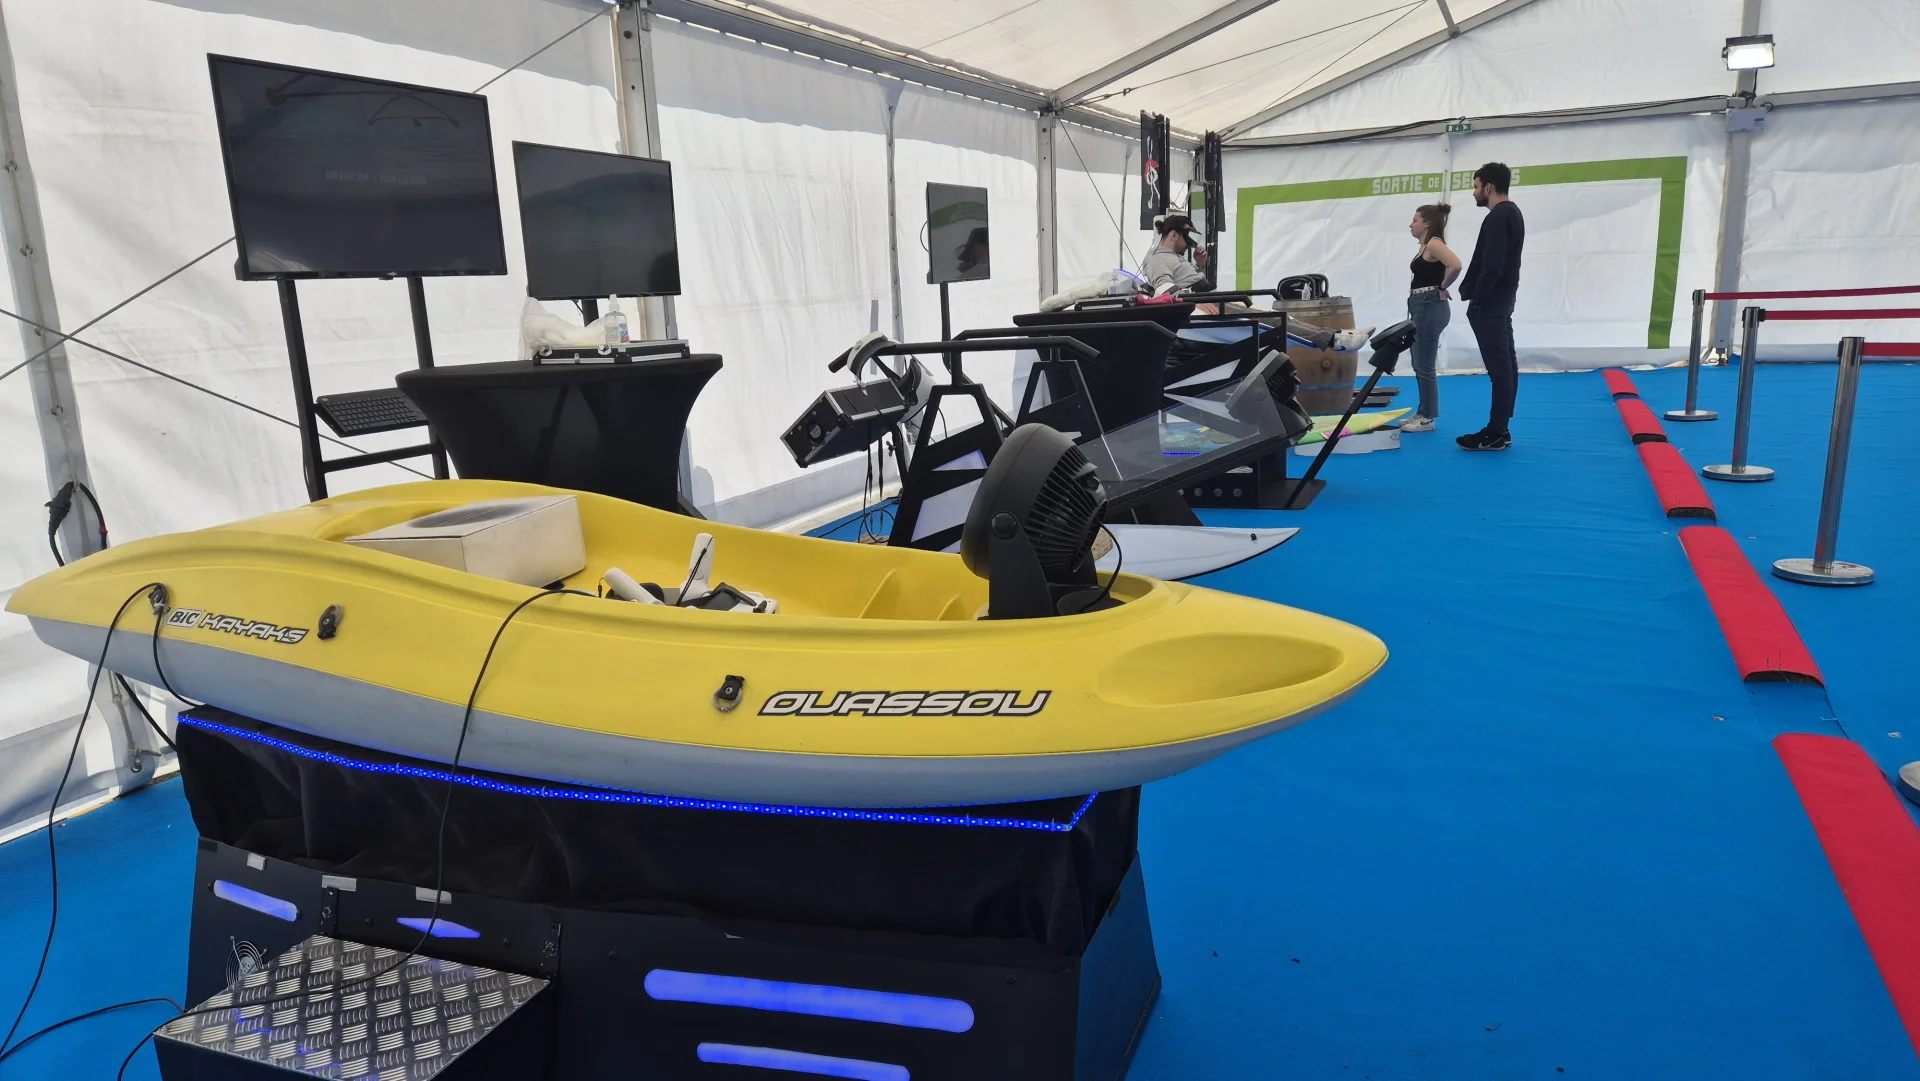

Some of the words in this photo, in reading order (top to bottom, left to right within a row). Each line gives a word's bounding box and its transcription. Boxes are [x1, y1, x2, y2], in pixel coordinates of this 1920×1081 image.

[1372, 175, 1423, 195] SORTIE
[1428, 177, 1439, 189] DE
[199, 613, 309, 644] KAYAKS
[757, 691, 1052, 716] OUASSOU
